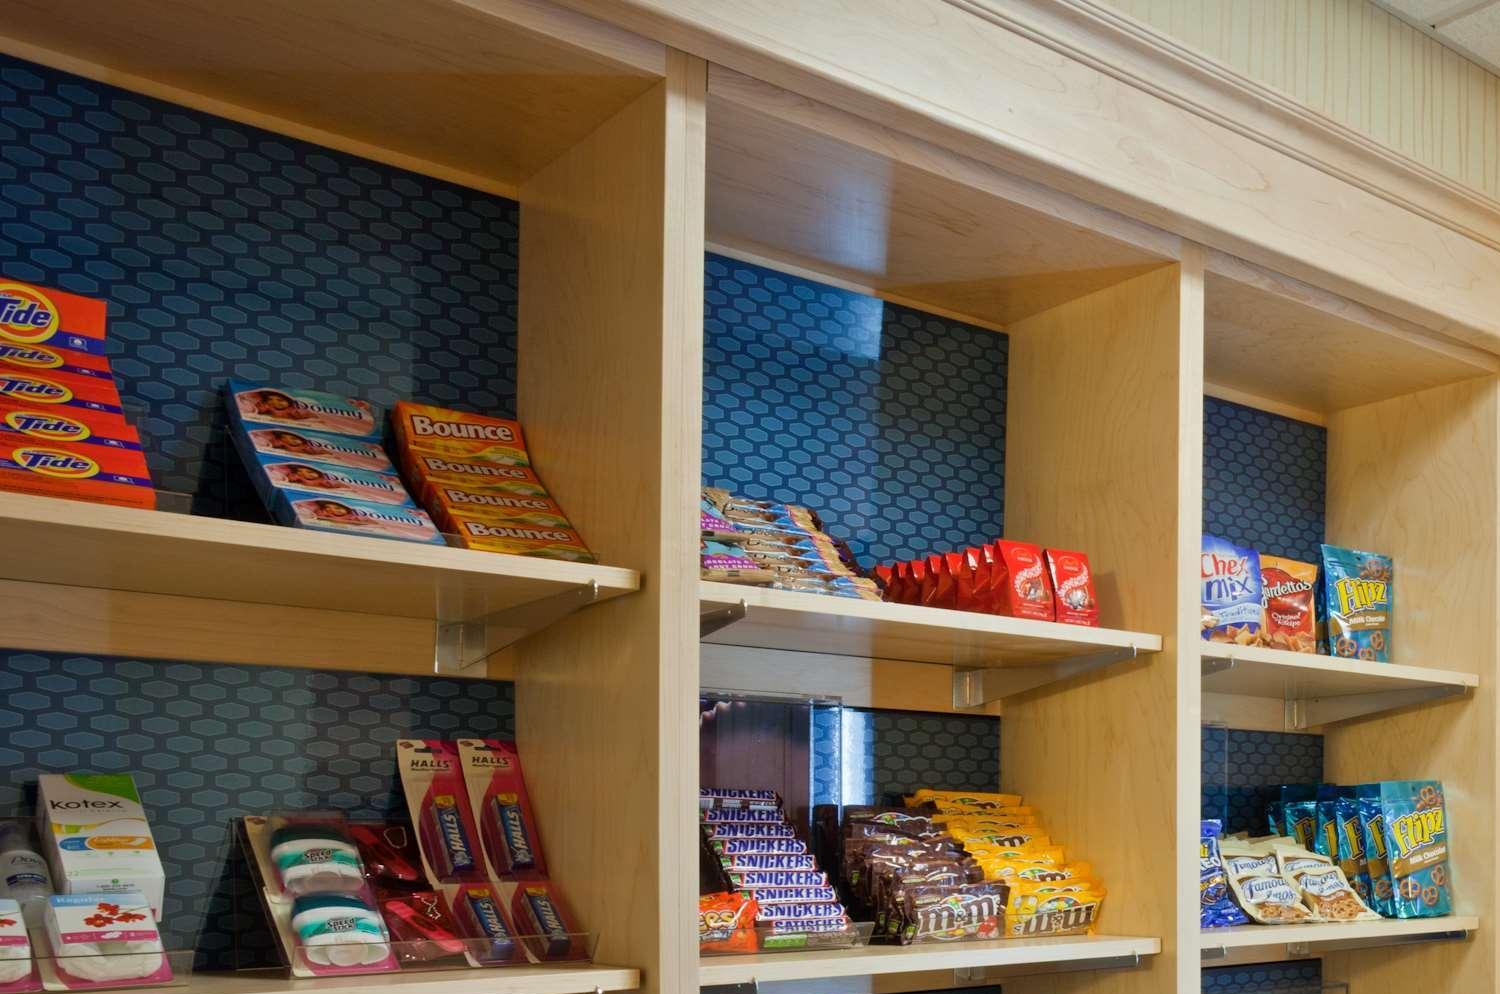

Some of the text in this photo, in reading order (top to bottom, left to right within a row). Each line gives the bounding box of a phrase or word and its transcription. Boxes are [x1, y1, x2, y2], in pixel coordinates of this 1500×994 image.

[0, 297, 52, 328] Tide
[2, 379, 65, 395] Tide
[14, 415, 84, 434] Tide
[410, 415, 514, 442] Bounce
[20, 451, 93, 470] Tide
[424, 456, 528, 480] Bounce
[445, 488, 550, 510] Bounce
[464, 521, 572, 542] Bounce
[1201, 553, 1249, 578] Chex
[1336, 577, 1387, 616] Flipz
[410, 759, 450, 768] HALLS
[472, 755, 510, 765] HALLS
[701, 787, 776, 798] SNICKERS
[50, 799, 124, 810] kotex
[708, 808, 784, 821] SNICKERS
[441, 812, 467, 854] HALLS
[507, 809, 531, 851] HALLS
[717, 823, 794, 836] SNICKERS
[1392, 808, 1446, 857] Flipz
[727, 839, 806, 853] SNICKERS
[735, 854, 813, 868] SNICKERS
[745, 871, 824, 885] SNICKERS
[755, 887, 834, 900] SNICKERS
[479, 899, 507, 933] HALLS
[764, 903, 843, 917] SNICKERS
[774, 918, 840, 931] SATISFIES
